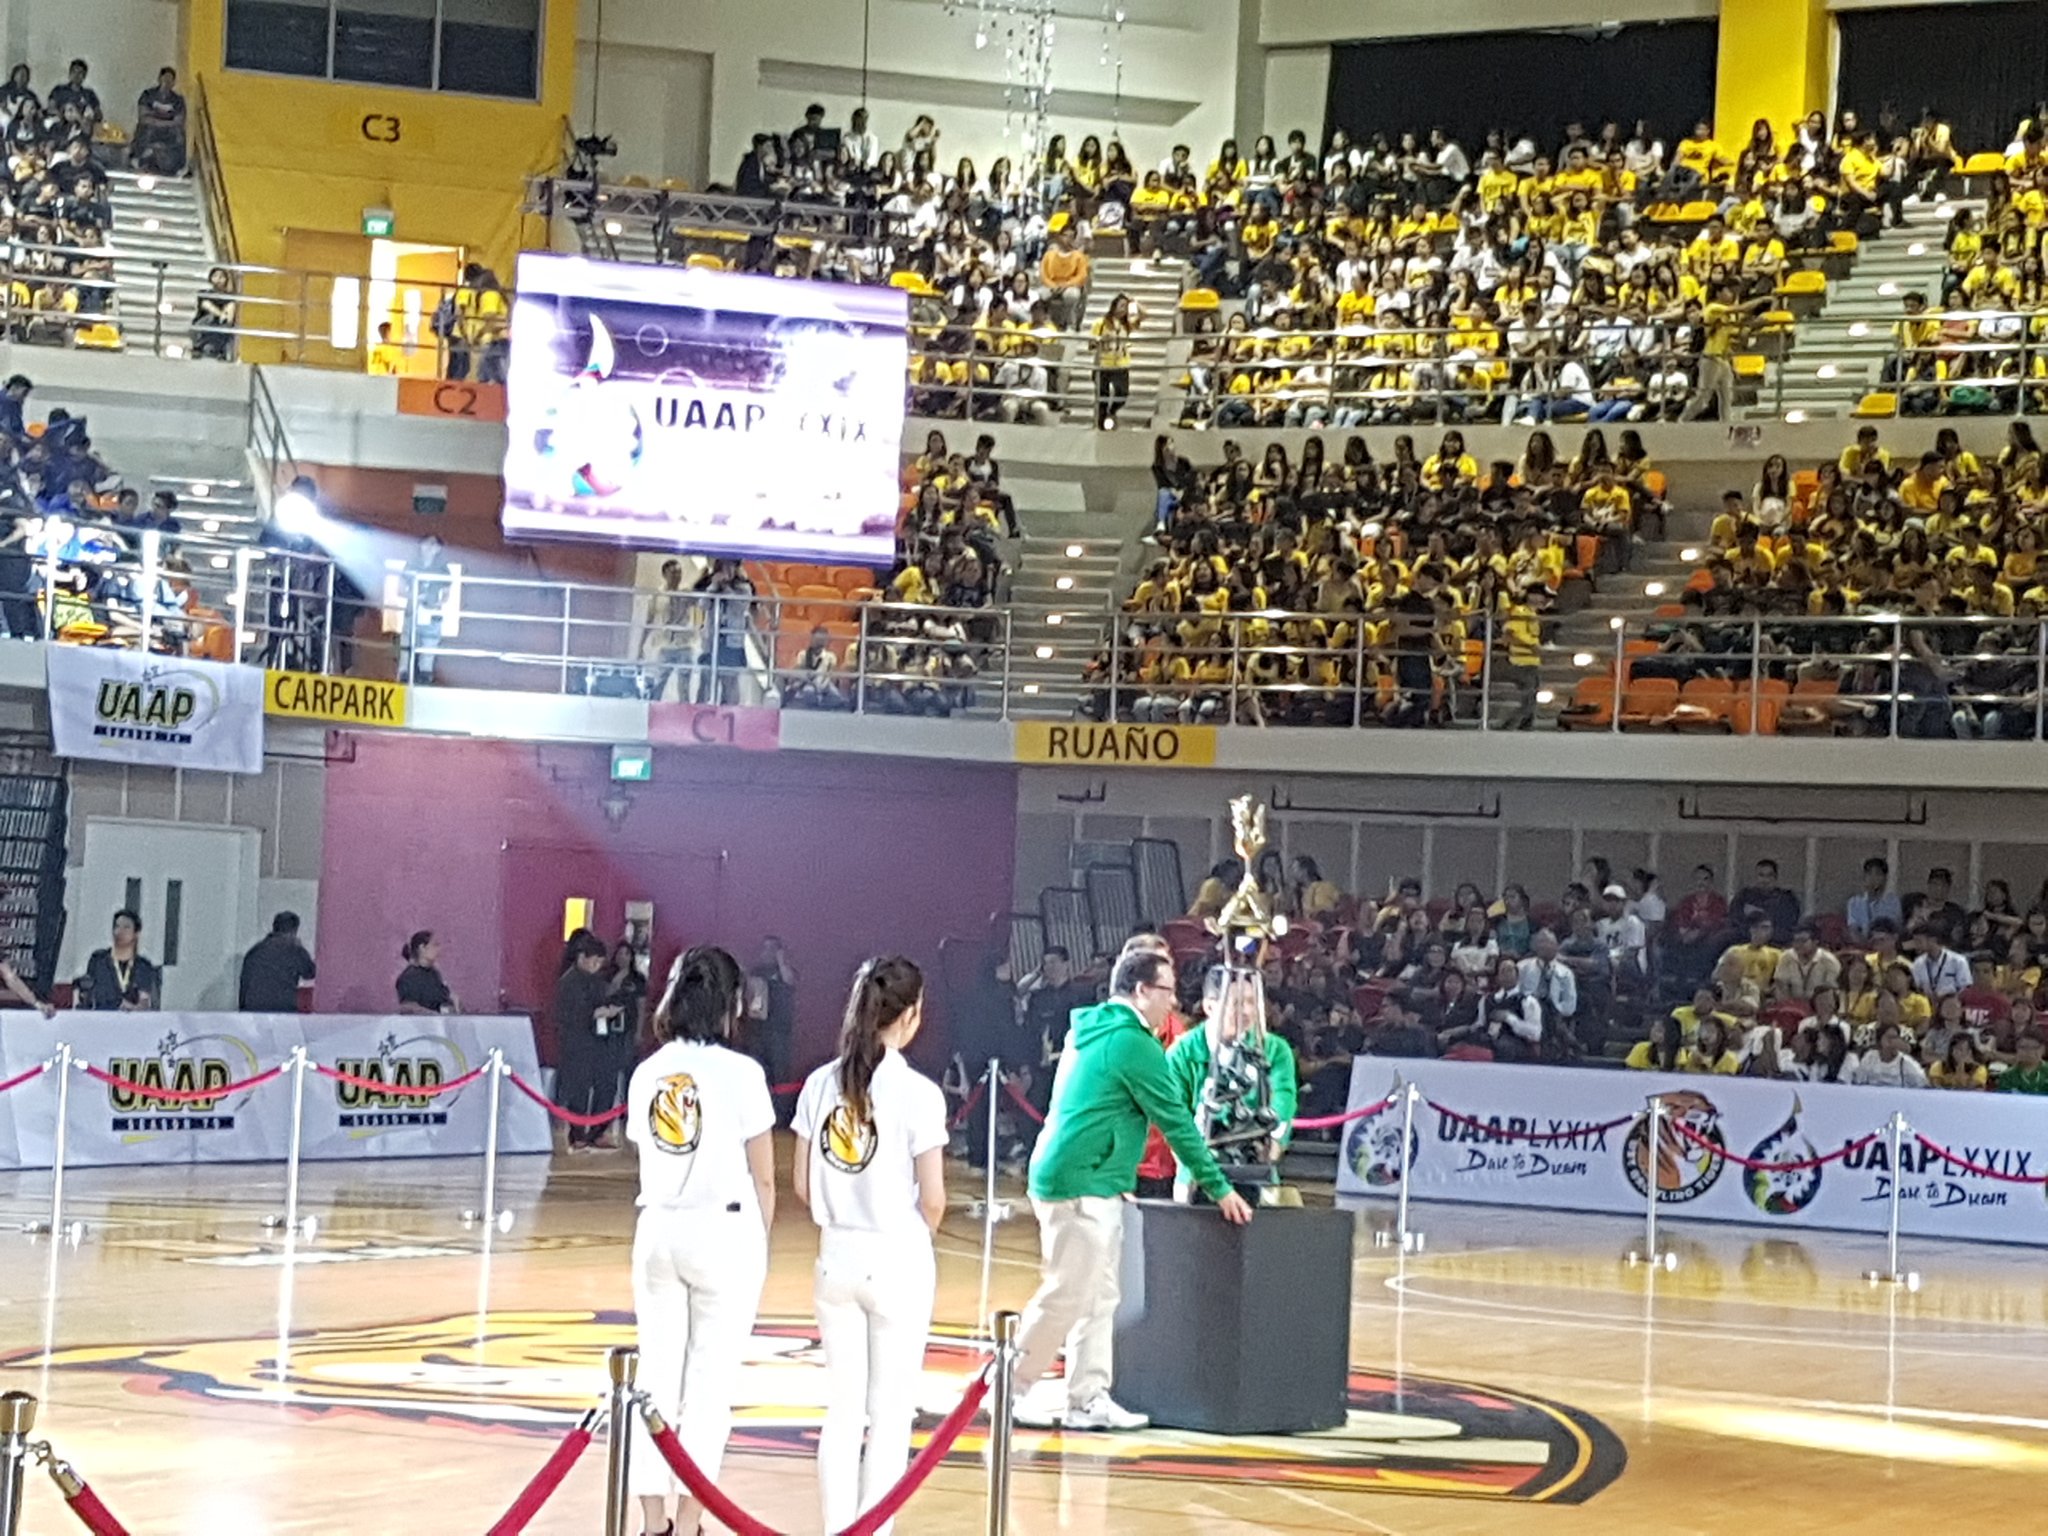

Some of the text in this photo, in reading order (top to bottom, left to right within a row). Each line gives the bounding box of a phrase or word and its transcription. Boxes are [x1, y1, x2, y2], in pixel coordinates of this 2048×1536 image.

[362, 114, 400, 142] C3
[433, 385, 477, 415] C2
[655, 396, 766, 433] UAAP
[95, 678, 196, 729] UAAP
[274, 676, 396, 720] CARPARK
[692, 709, 736, 743] C1
[1048, 726, 1180, 761] RUAÑO
[109, 1057, 231, 1113] UAAP
[335, 1057, 443, 1109] UAAP
